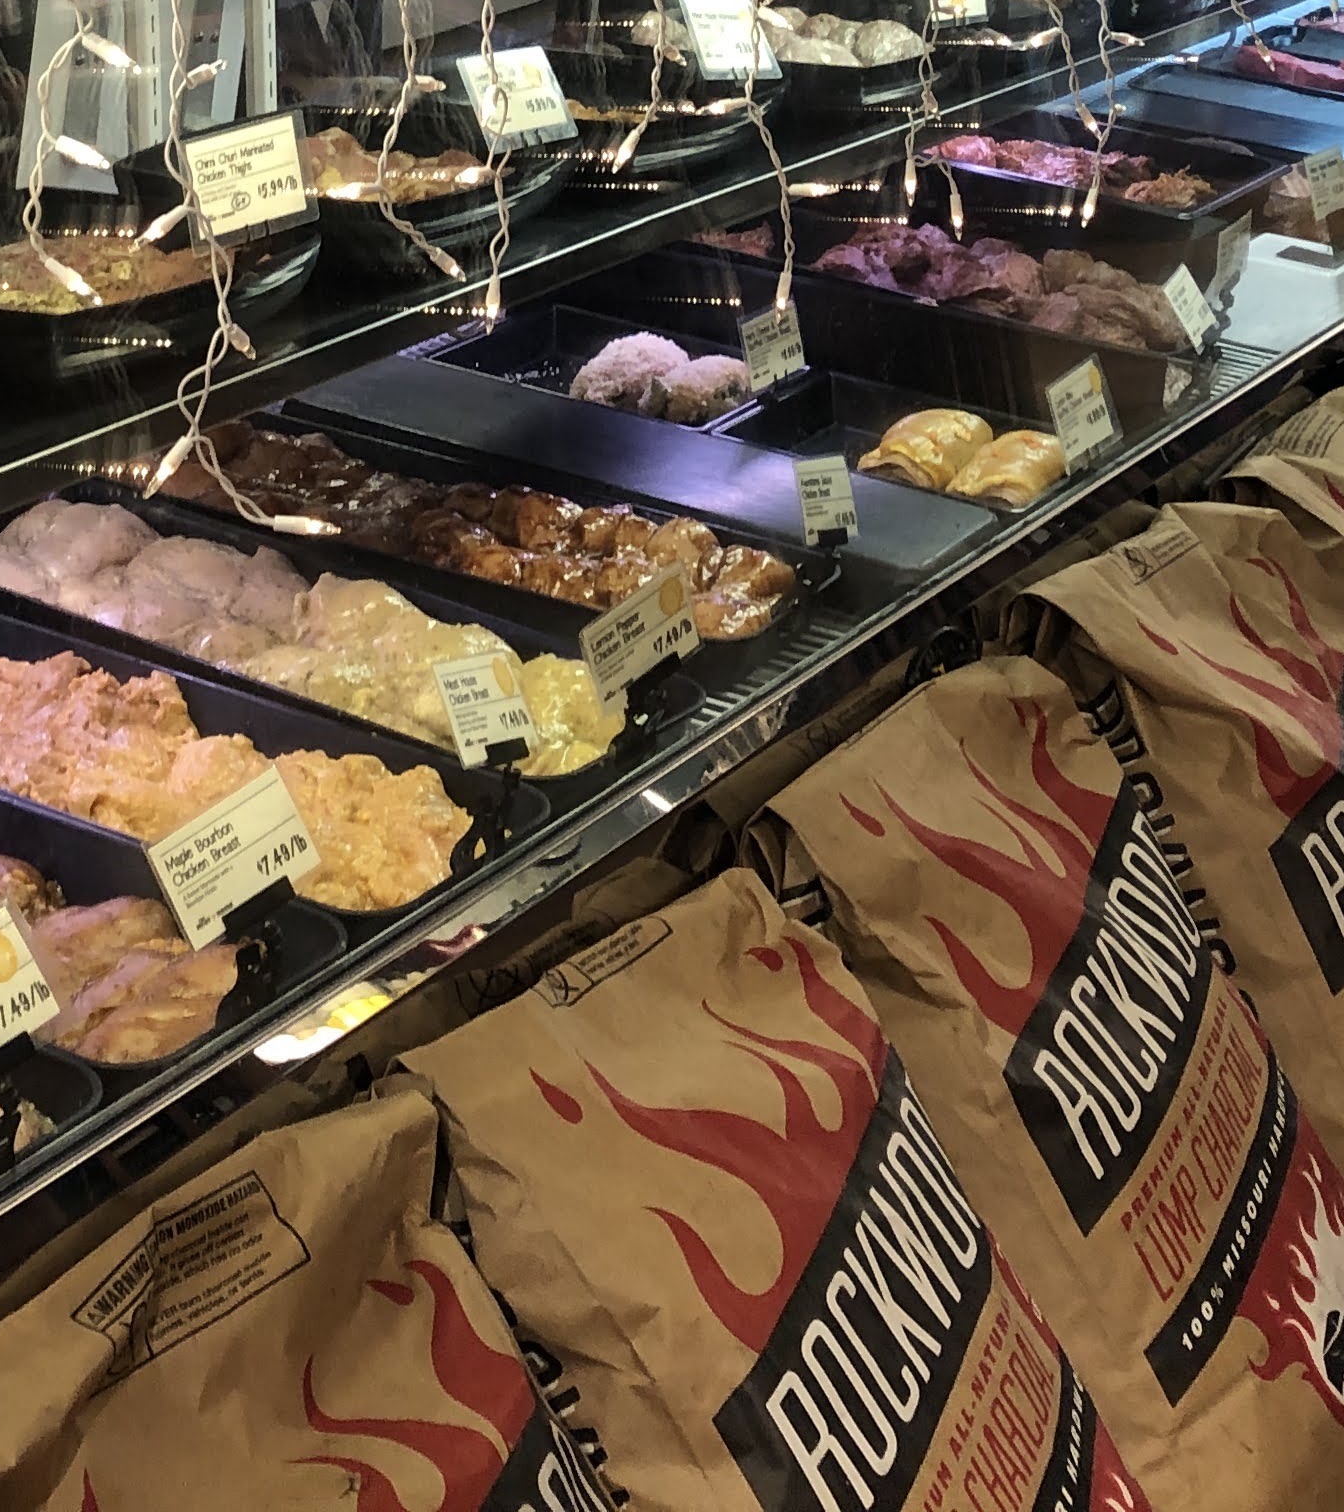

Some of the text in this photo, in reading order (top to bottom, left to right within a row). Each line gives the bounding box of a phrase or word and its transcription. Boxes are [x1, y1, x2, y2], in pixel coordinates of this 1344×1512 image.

[197, 171, 226, 184] Chicken
[257, 175, 298, 200] $5.99/lb
[594, 640, 621, 665] Chicken
[164, 822, 235, 872] Maple Bourbon
[172, 857, 210, 887] Chicken
[210, 836, 242, 862] Breast
[257, 833, 308, 877] $7.49/lb
[1121, 1116, 1184, 1232] PREMIUM
[1134, 1023, 1262, 1303] LUMP CHARCOAL
[96, 1253, 150, 1316] WARNING
[176, 1198, 227, 1236] MONOXIDE
[1181, 1281, 1225, 1351] 100%
[1225, 1166, 1272, 1274] MISSOURI
[179, 1294, 202, 1312] burn
